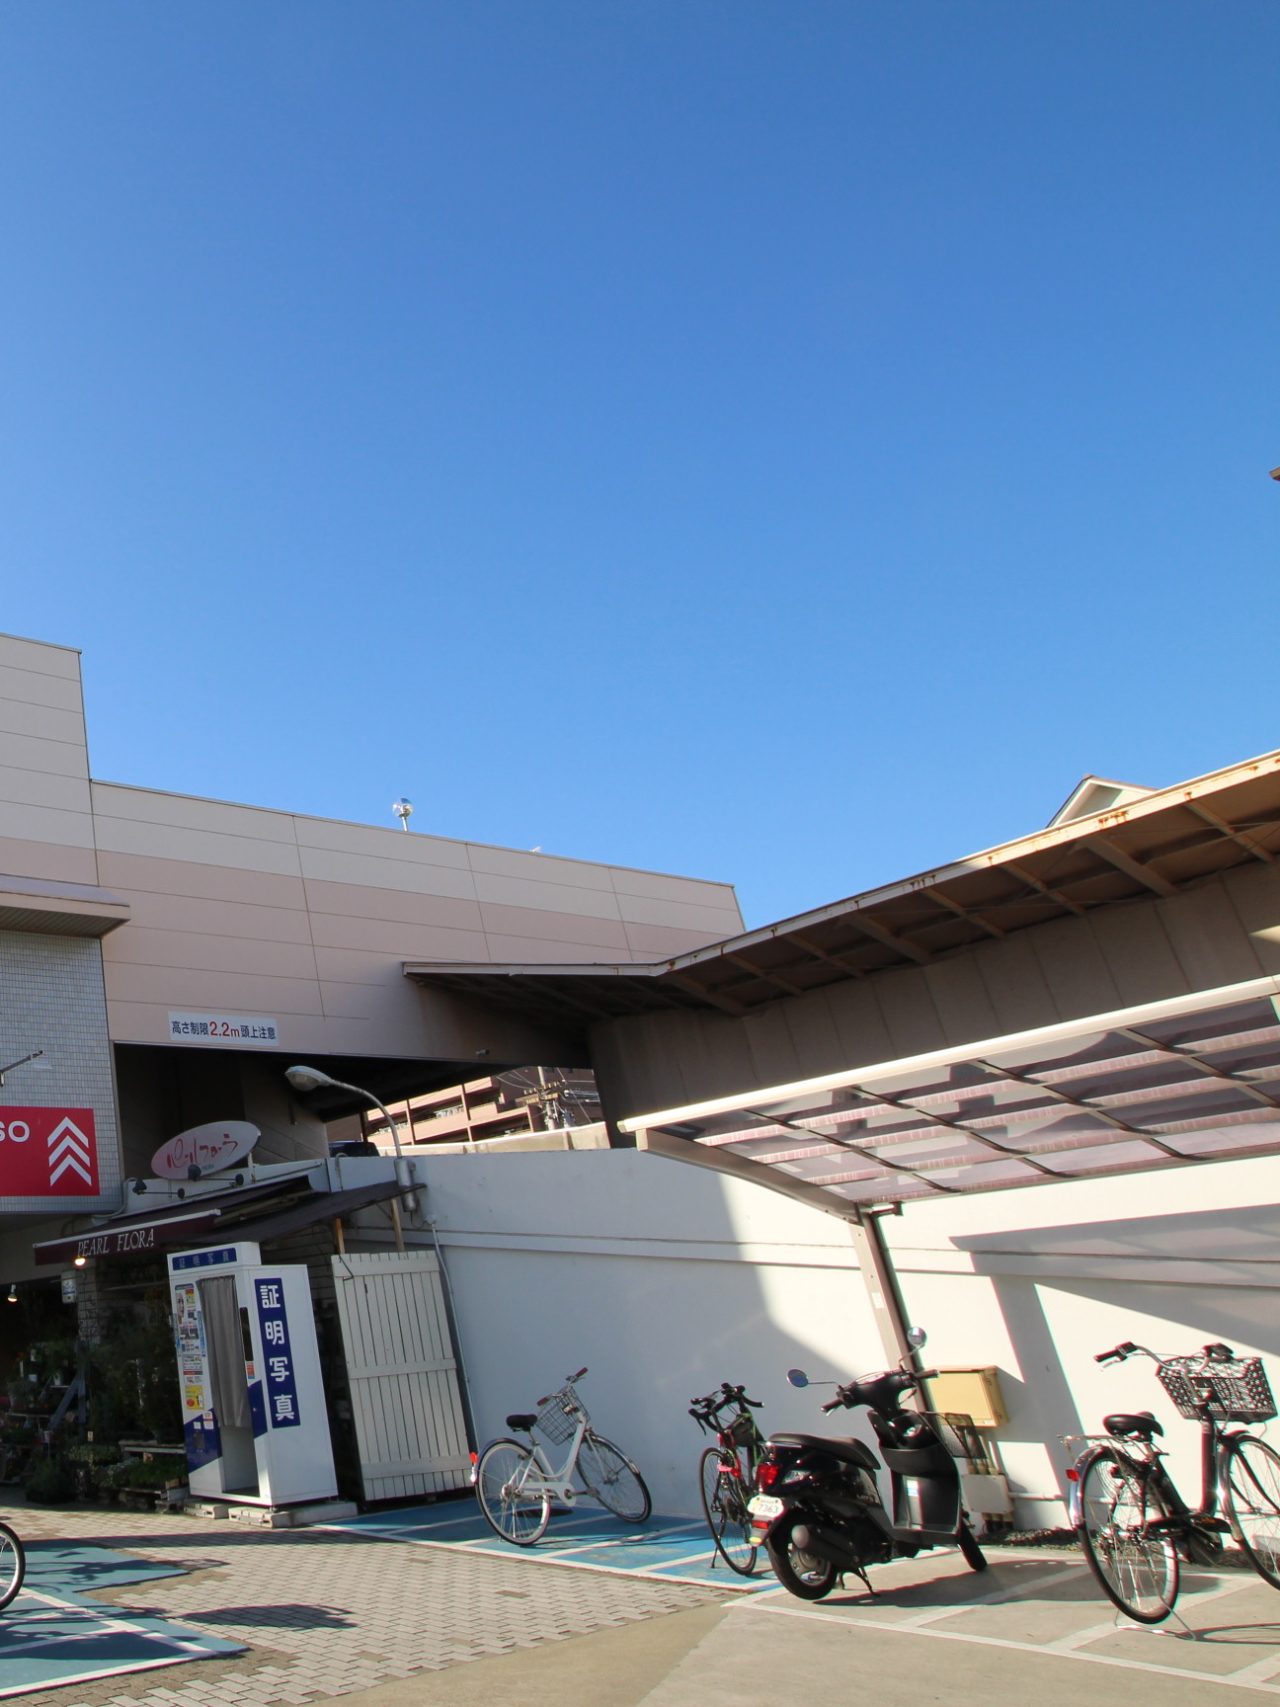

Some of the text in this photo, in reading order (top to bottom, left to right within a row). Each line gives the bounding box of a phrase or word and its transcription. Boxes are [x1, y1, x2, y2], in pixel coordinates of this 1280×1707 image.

[171, 1020, 276, 1040] 高さ制限2.2m頭上注意
[77, 1228, 155, 1257] PEARL FLORA
[259, 1284, 296, 1421] 証明写真
